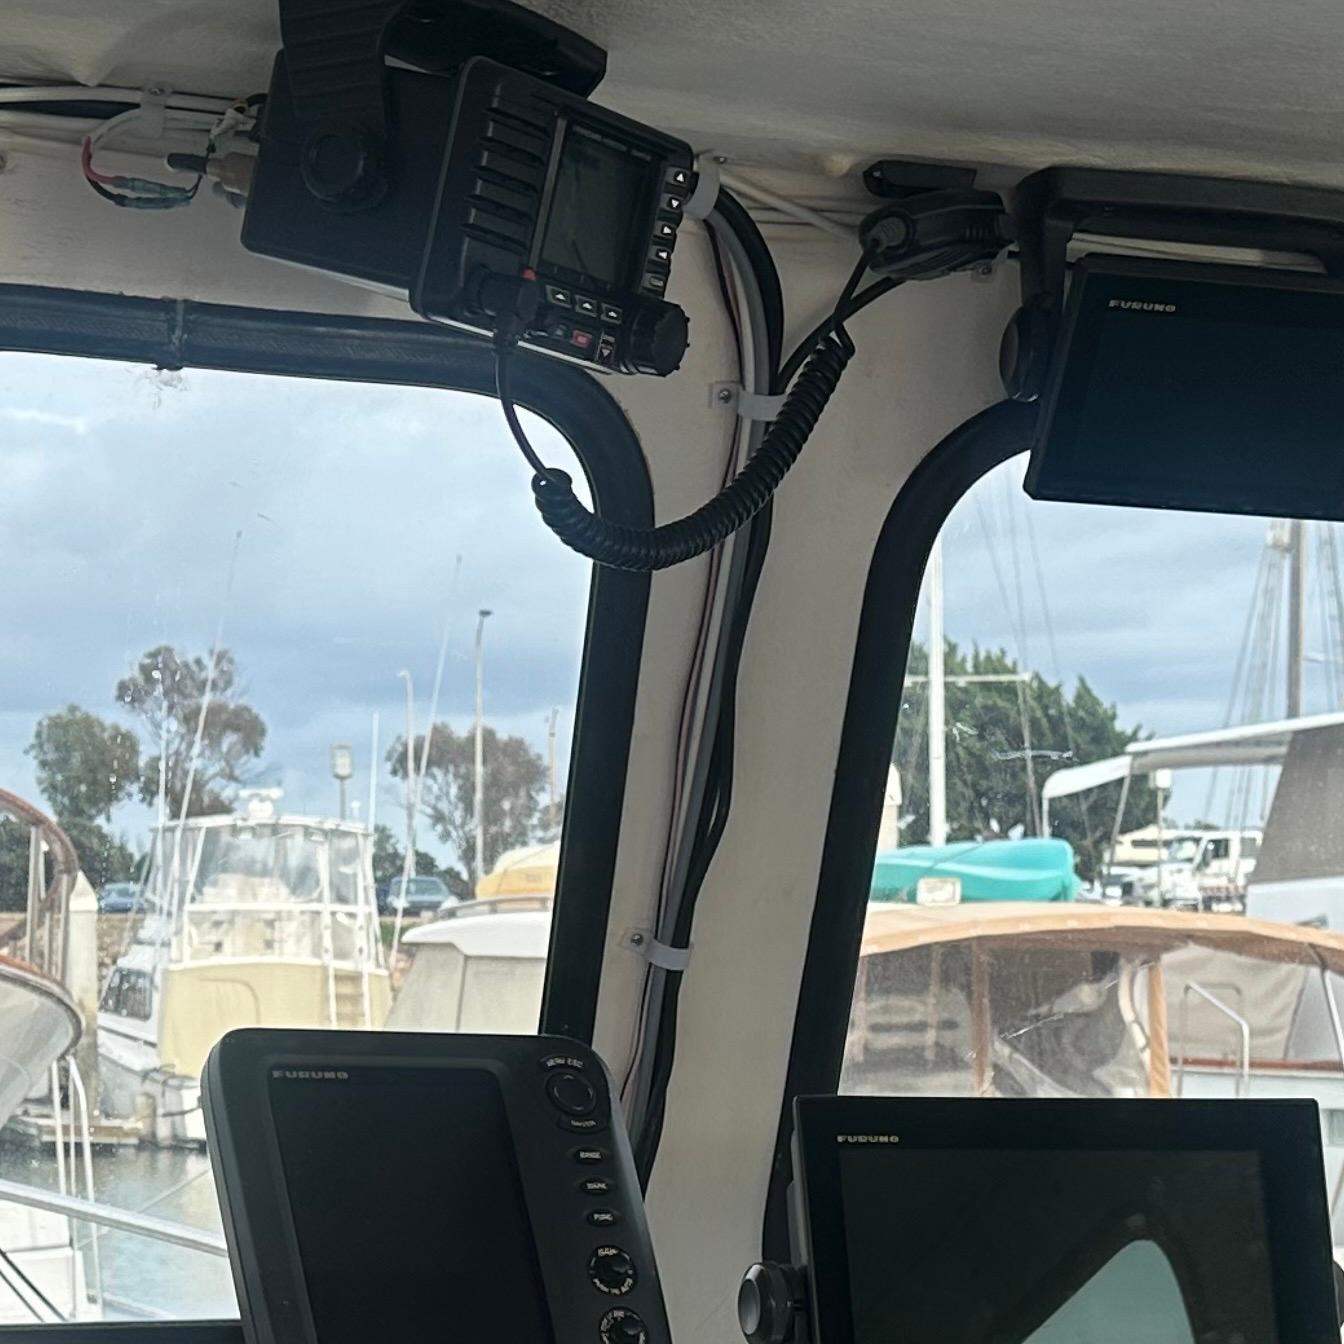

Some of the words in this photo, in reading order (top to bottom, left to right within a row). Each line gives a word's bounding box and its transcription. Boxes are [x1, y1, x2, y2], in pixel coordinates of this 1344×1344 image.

[1108, 299, 1176, 312] FURUNO
[272, 1070, 349, 1080] FURUNO
[837, 1135, 899, 1144] FURUNO
